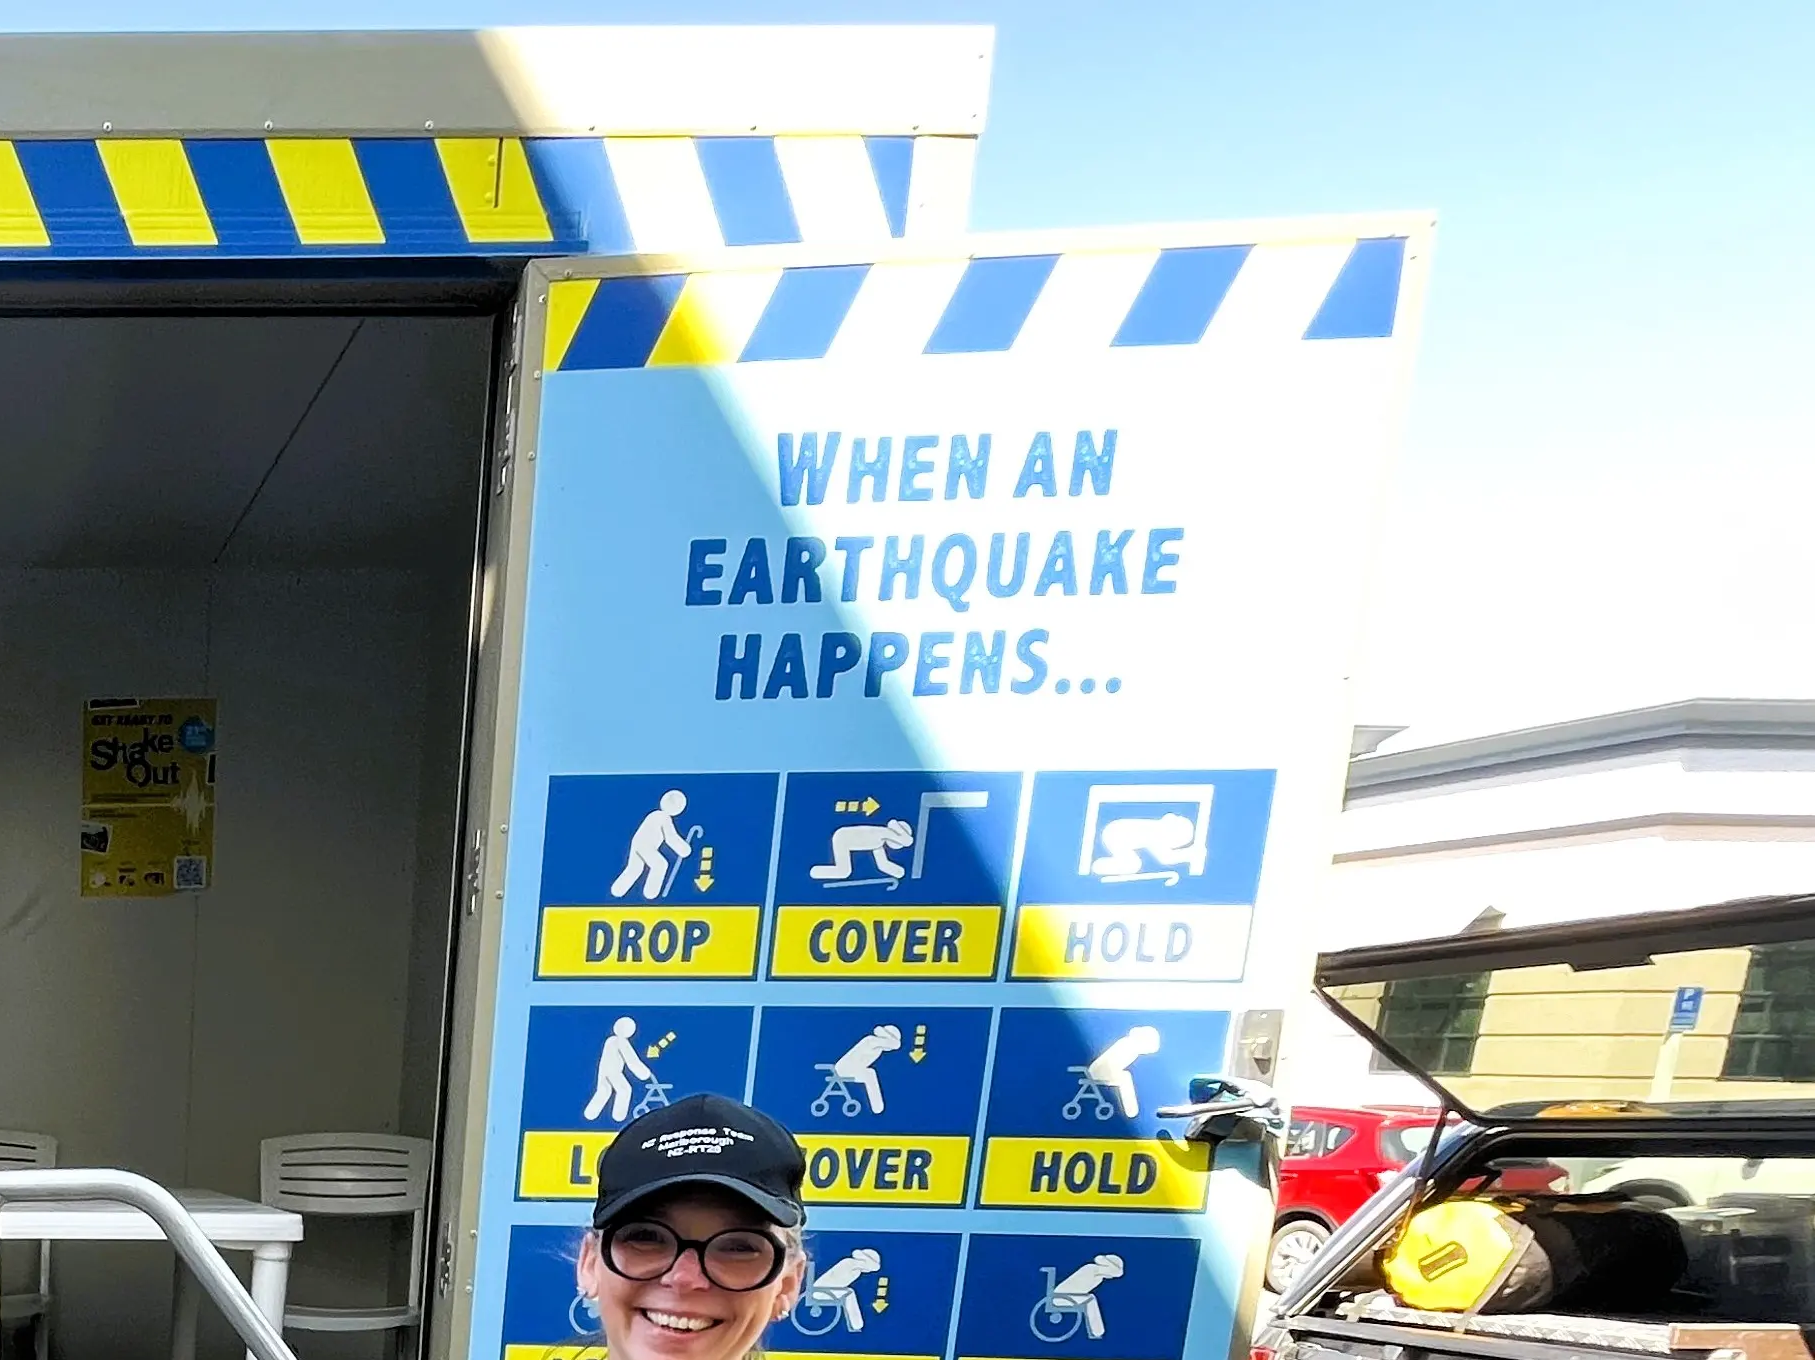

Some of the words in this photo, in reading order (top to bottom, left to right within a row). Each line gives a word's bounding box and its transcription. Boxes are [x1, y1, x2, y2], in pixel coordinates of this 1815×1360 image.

[776, 430, 993, 508] WHEN
[1012, 427, 1119, 500] AN
[684, 525, 1186, 613] EARTHQUAKE
[714, 627, 1124, 702] HAPPENS...
[90, 727, 174, 771] Shake
[126, 760, 181, 788] Out
[585, 919, 712, 964] DROP
[807, 919, 964, 965] COVER
[1064, 919, 1195, 966] HOLD
[803, 1145, 934, 1191] OVER
[1029, 1150, 1159, 1195] HOLD
